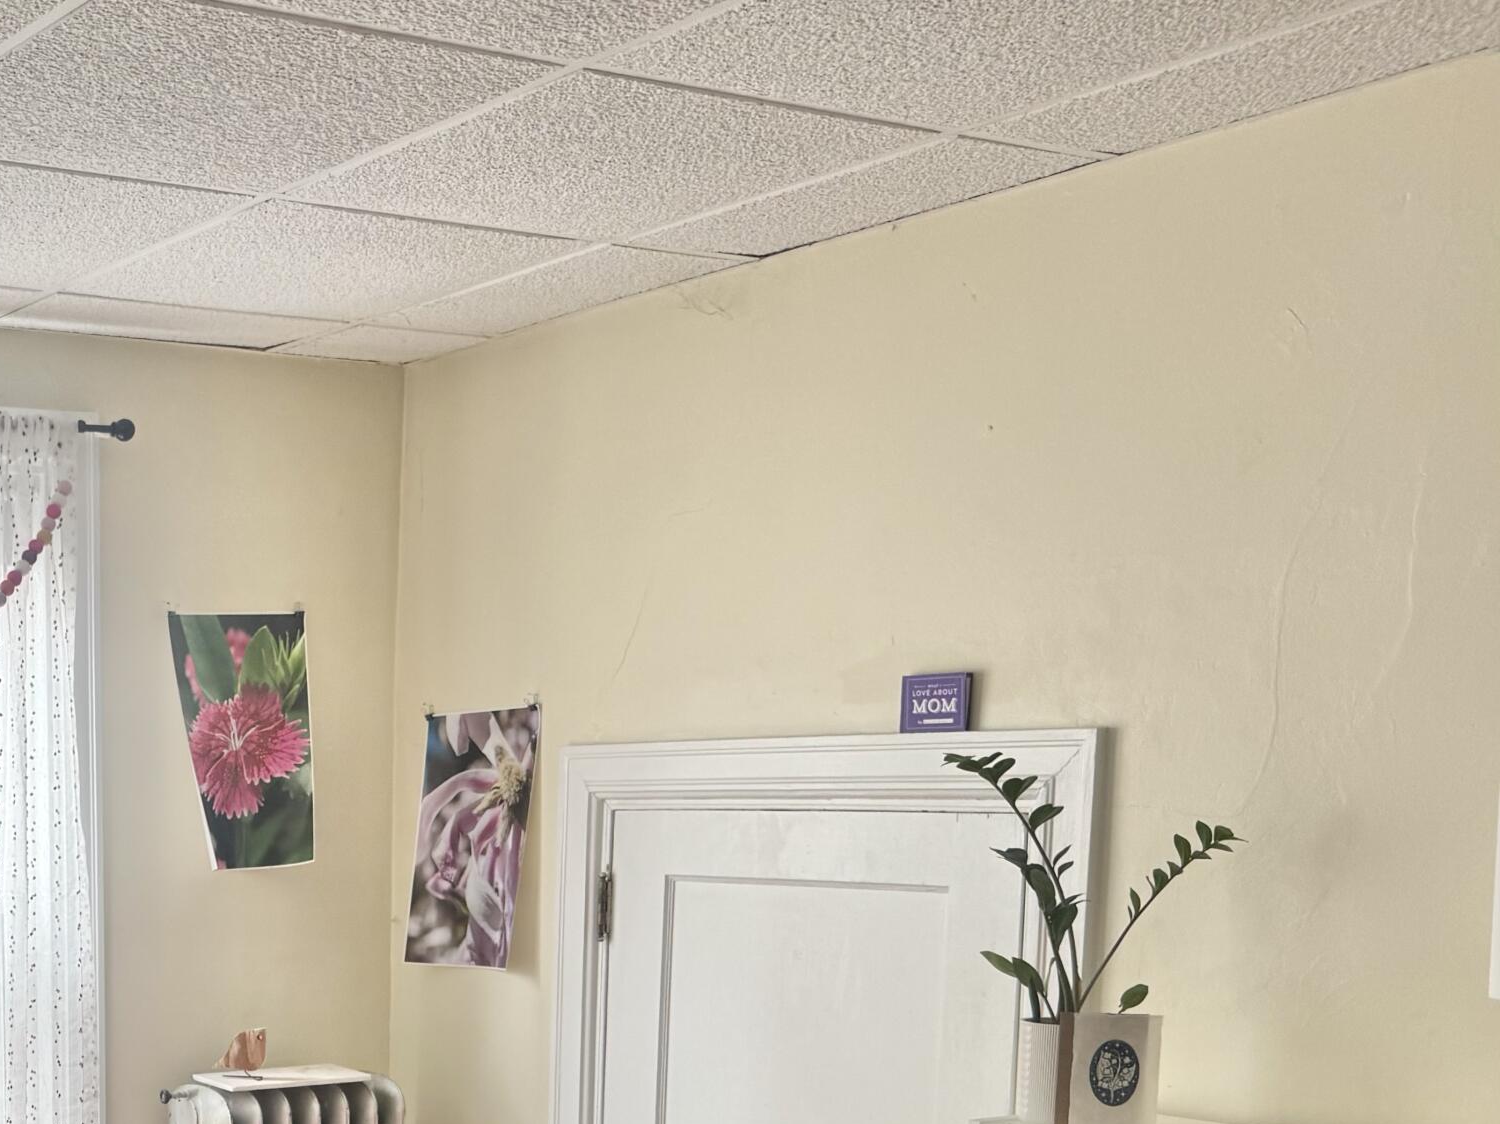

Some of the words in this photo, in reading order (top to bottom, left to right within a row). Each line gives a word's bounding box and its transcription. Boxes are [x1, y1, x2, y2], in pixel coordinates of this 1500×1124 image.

[912, 689, 930, 697] LOVE
[933, 688, 958, 696] ABOUT
[912, 698, 958, 714] MOM
